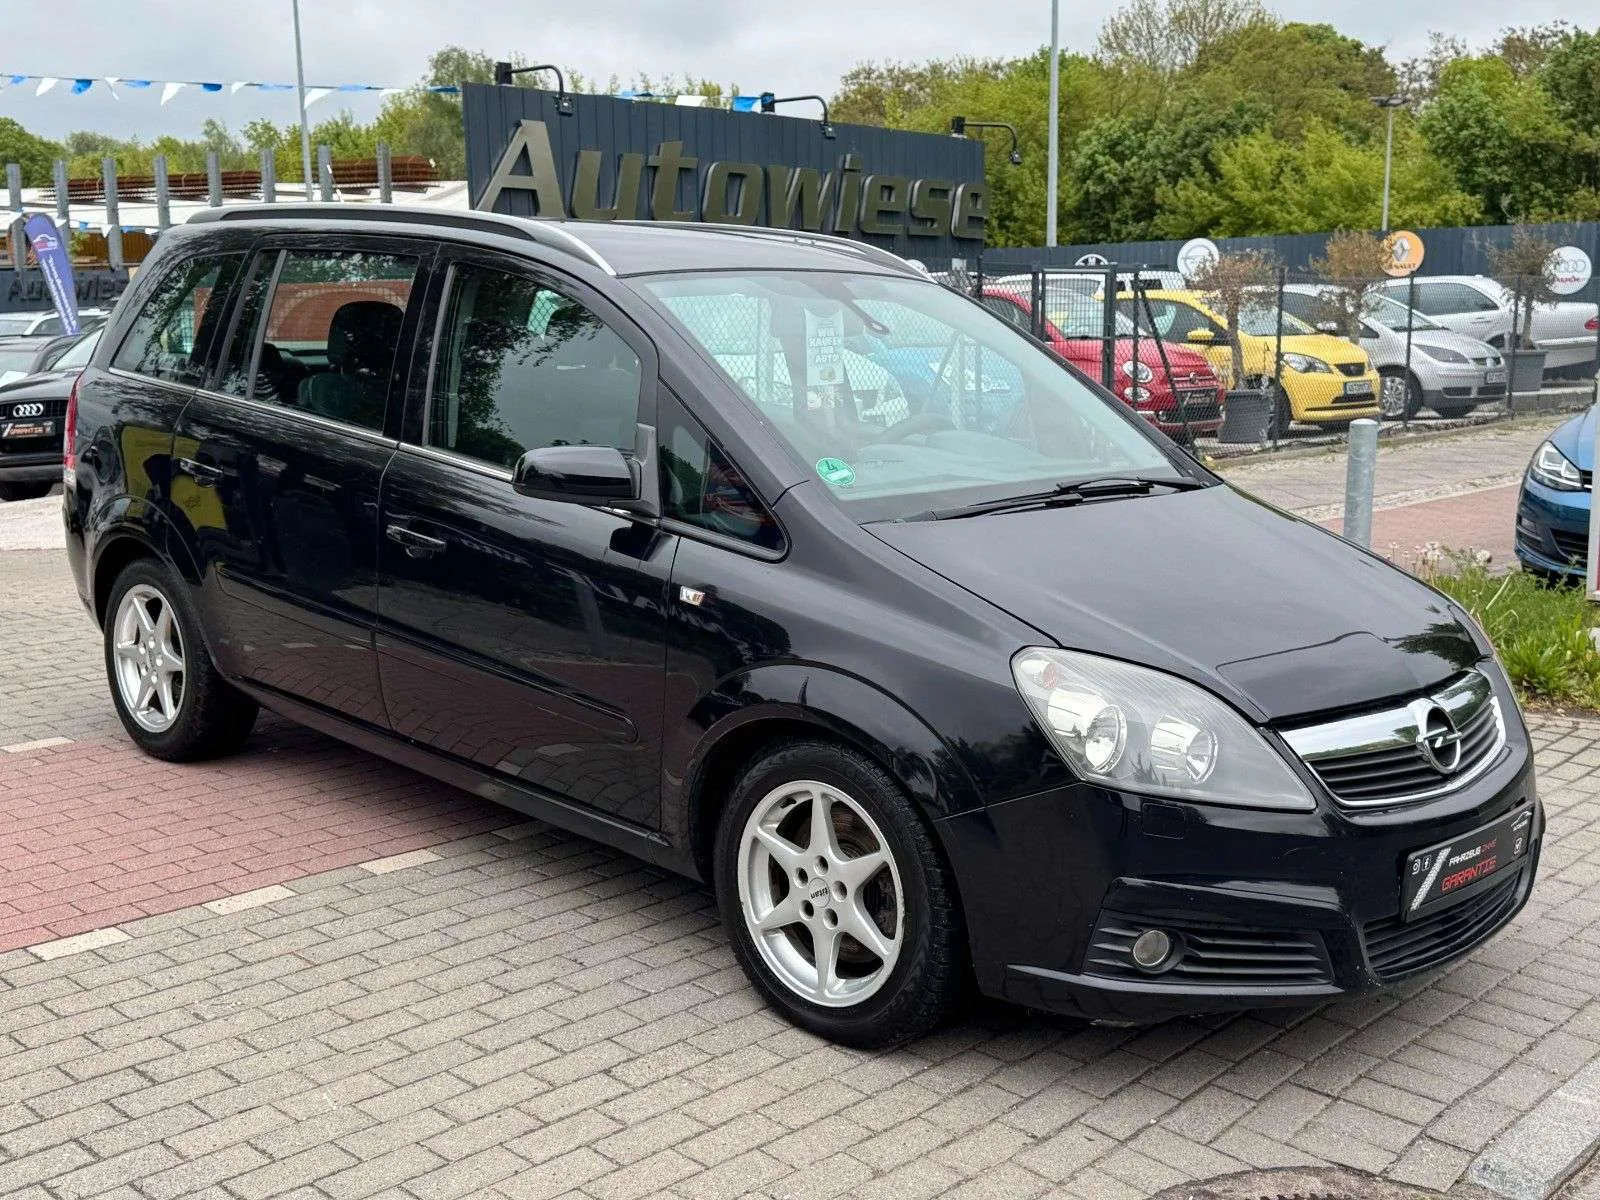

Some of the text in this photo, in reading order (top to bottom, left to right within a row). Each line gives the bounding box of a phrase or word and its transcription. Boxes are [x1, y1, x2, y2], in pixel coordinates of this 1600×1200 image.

[475, 118, 988, 240] Autowiese
[1441, 855, 1497, 892] GARANTIE
[810, 888, 828, 899] titan
